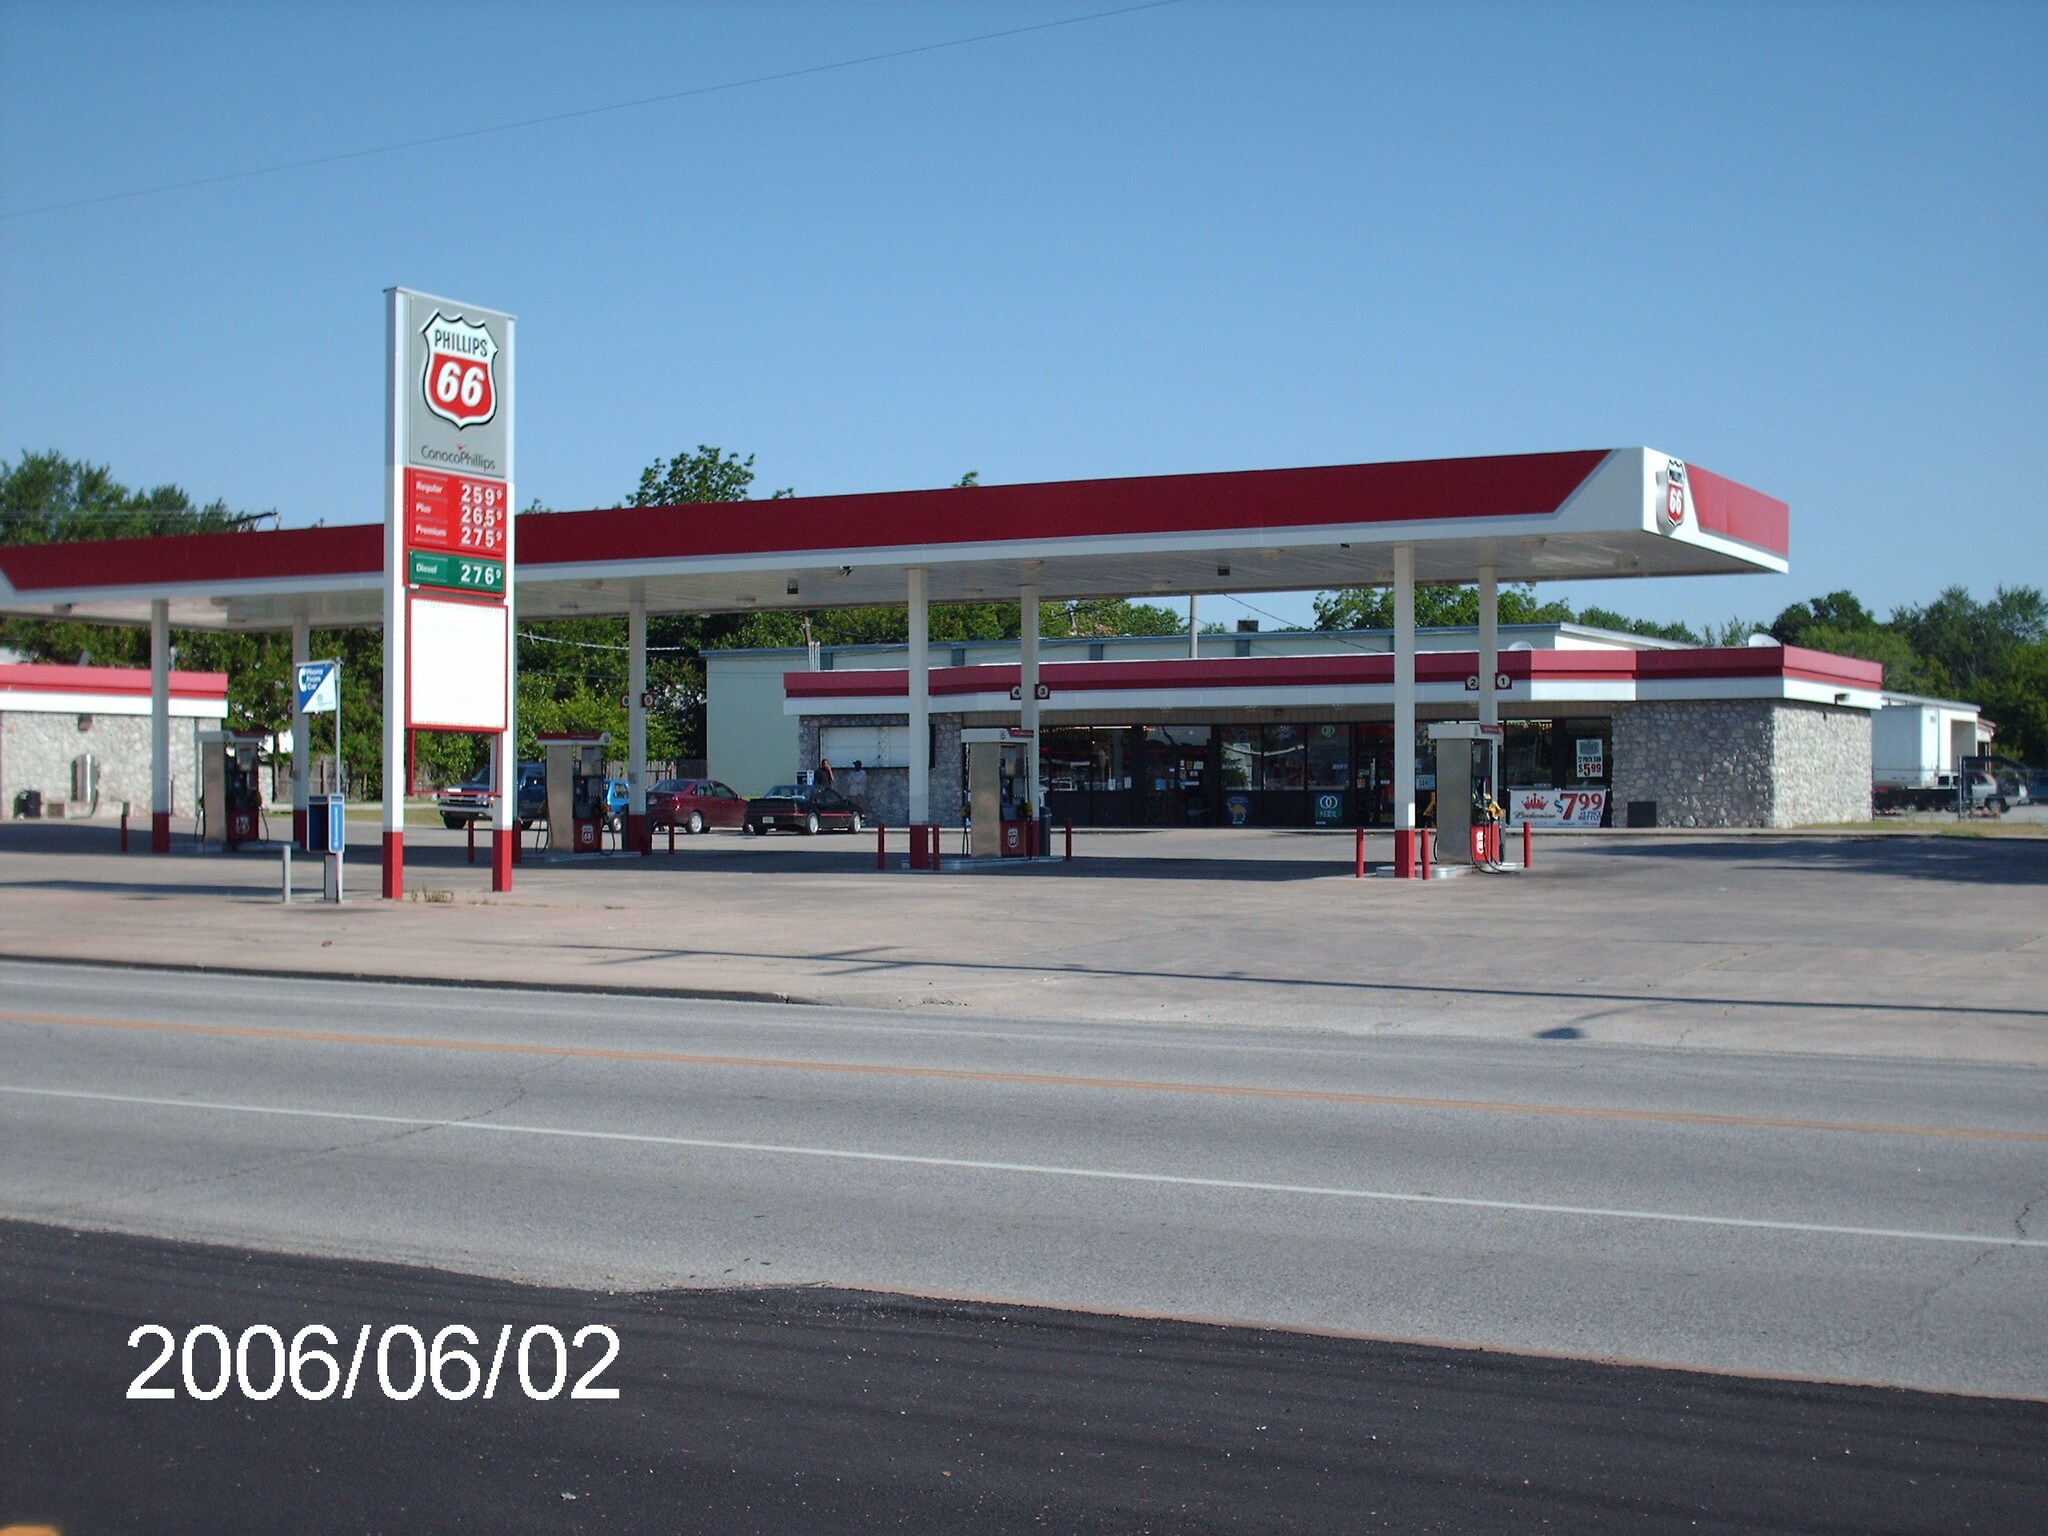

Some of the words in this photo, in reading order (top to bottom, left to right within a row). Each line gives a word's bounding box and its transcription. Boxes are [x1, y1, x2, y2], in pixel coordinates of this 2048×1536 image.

[434, 329, 488, 357] PHILLIPS
[437, 361, 485, 407] 66
[421, 445, 496, 472] ConocoPhillips
[416, 481, 444, 494] Regular
[416, 502, 432, 514] Plus
[416, 524, 447, 537] Premium
[416, 563, 438, 574] Diesel
[1554, 793, 1603, 820] $799
